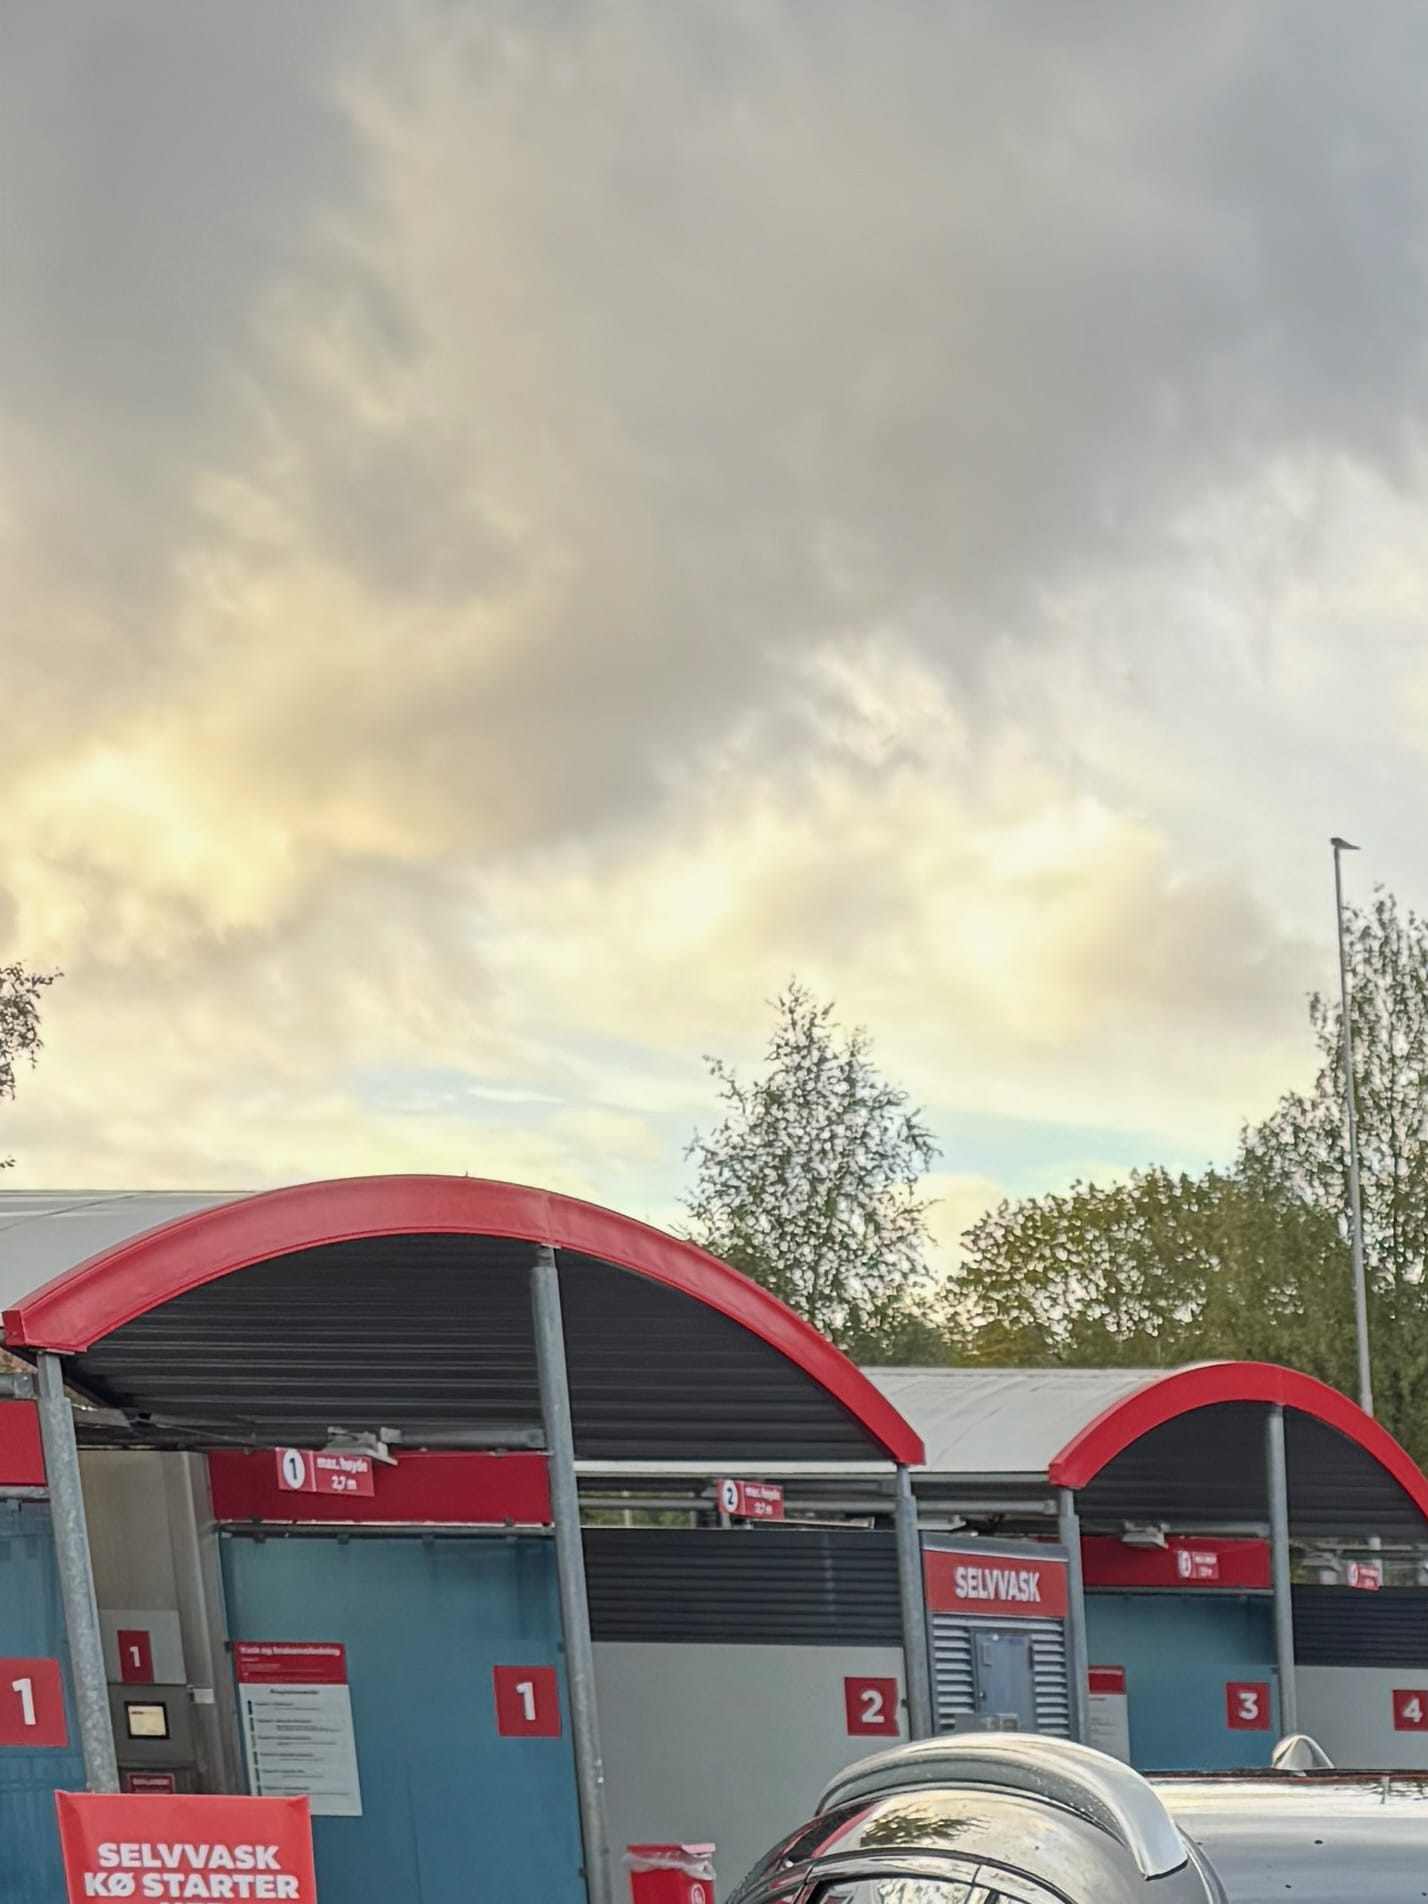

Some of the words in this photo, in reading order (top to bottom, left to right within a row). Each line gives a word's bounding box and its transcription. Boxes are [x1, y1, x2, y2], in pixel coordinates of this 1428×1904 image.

[288, 1457, 298, 1481] 1
[726, 1487, 734, 1505] 2
[954, 1566, 1041, 1602] SELVVASK
[129, 1645, 141, 1668] 1
[12, 1677, 36, 1726] 1
[516, 1681, 536, 1721] 1
[861, 1689, 885, 1723] 2
[1238, 1692, 1259, 1720] 3
[1402, 1697, 1423, 1723] 4
[97, 1842, 281, 1870] SELVVASK
[84, 1871, 136, 1897] KØ
[142, 1872, 301, 1899] STARTER
